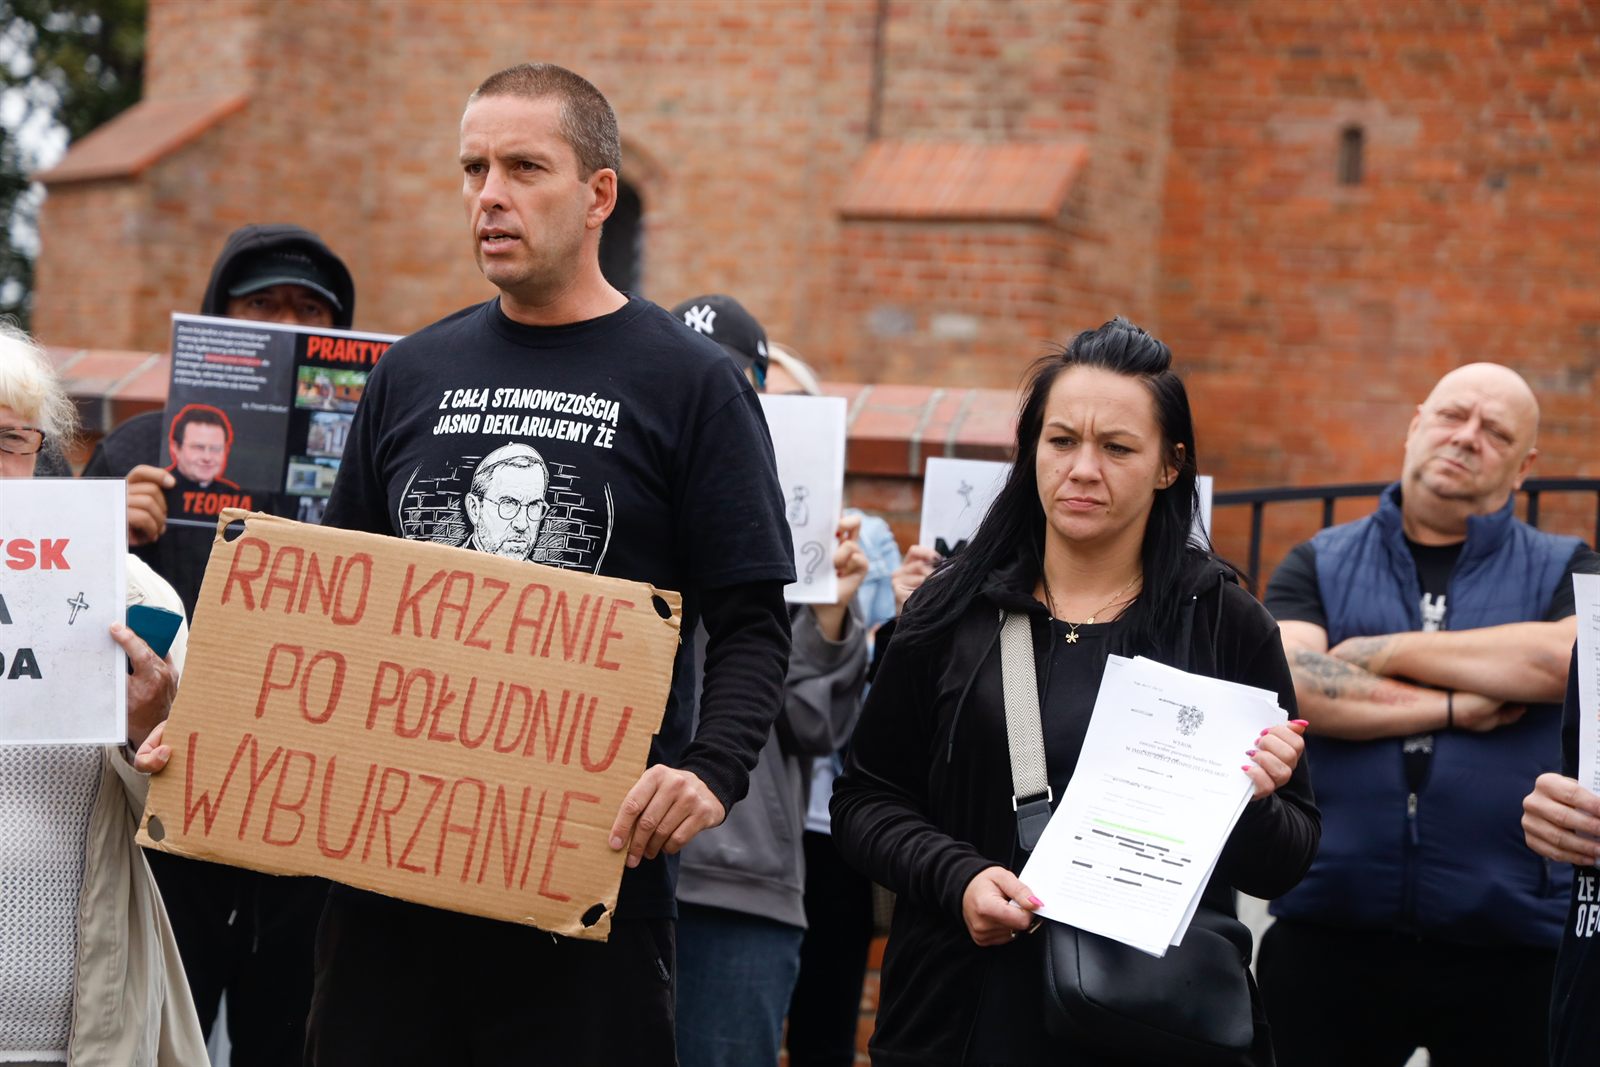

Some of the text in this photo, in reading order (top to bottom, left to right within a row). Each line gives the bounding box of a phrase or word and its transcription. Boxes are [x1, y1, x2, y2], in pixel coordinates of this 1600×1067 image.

[439, 388, 620, 427] Z CAŁĄ STANOWCZOŚCIĄ
[433, 414, 616, 448] JASNO DEKLARUJEMY ŻE
[0, 538, 71, 570] SK
[221, 536, 636, 671] RANO KAZANIE
[0, 648, 43, 680] A
[254, 643, 634, 773] PO POŁUDNIU
[182, 731, 601, 903] WYBURZANIE
